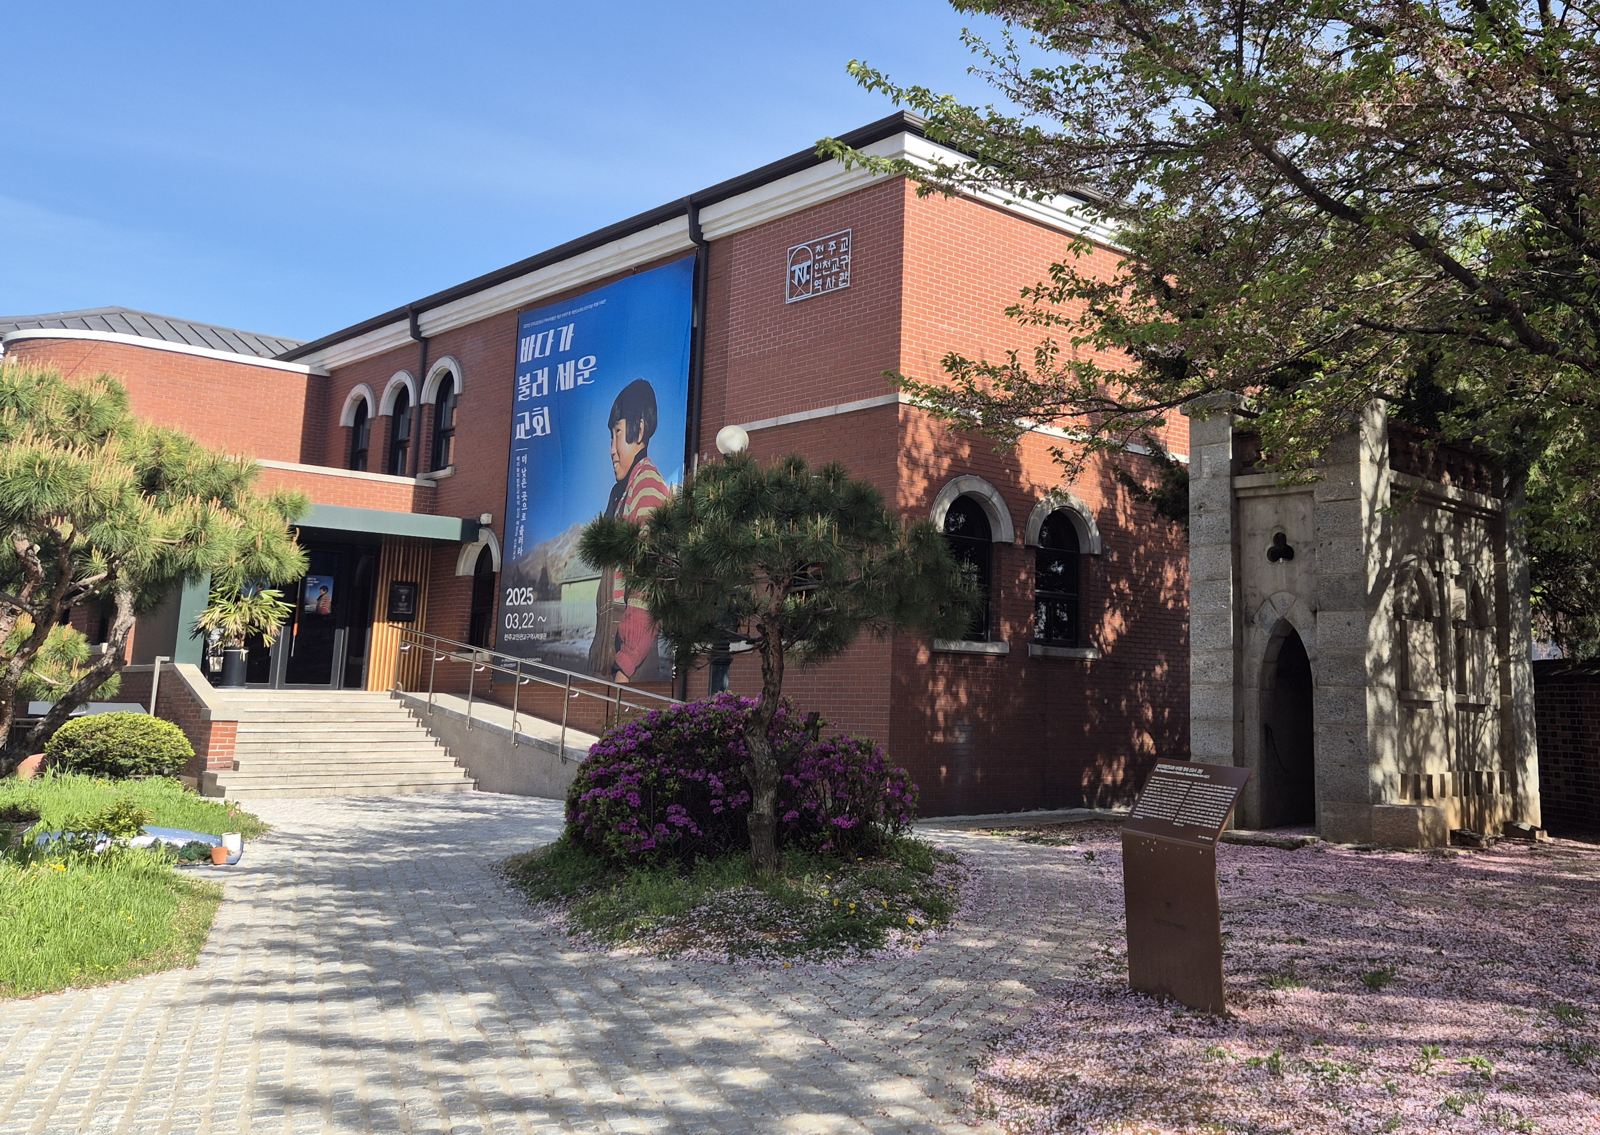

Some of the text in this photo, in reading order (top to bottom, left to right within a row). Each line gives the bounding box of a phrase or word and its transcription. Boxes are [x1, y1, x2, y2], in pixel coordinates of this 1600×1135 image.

[815, 237, 849, 260] 천주교
[814, 254, 850, 278] 인천교구
[813, 271, 850, 292] 역사관
[520, 323, 575, 364] 바다가
[518, 355, 598, 401] 불러 세운
[515, 406, 551, 440] 교회
[520, 466, 528, 489] 낮은
[520, 491, 528, 521] 곳으로
[505, 587, 534, 605] 2025
[505, 612, 535, 630] 03.22
